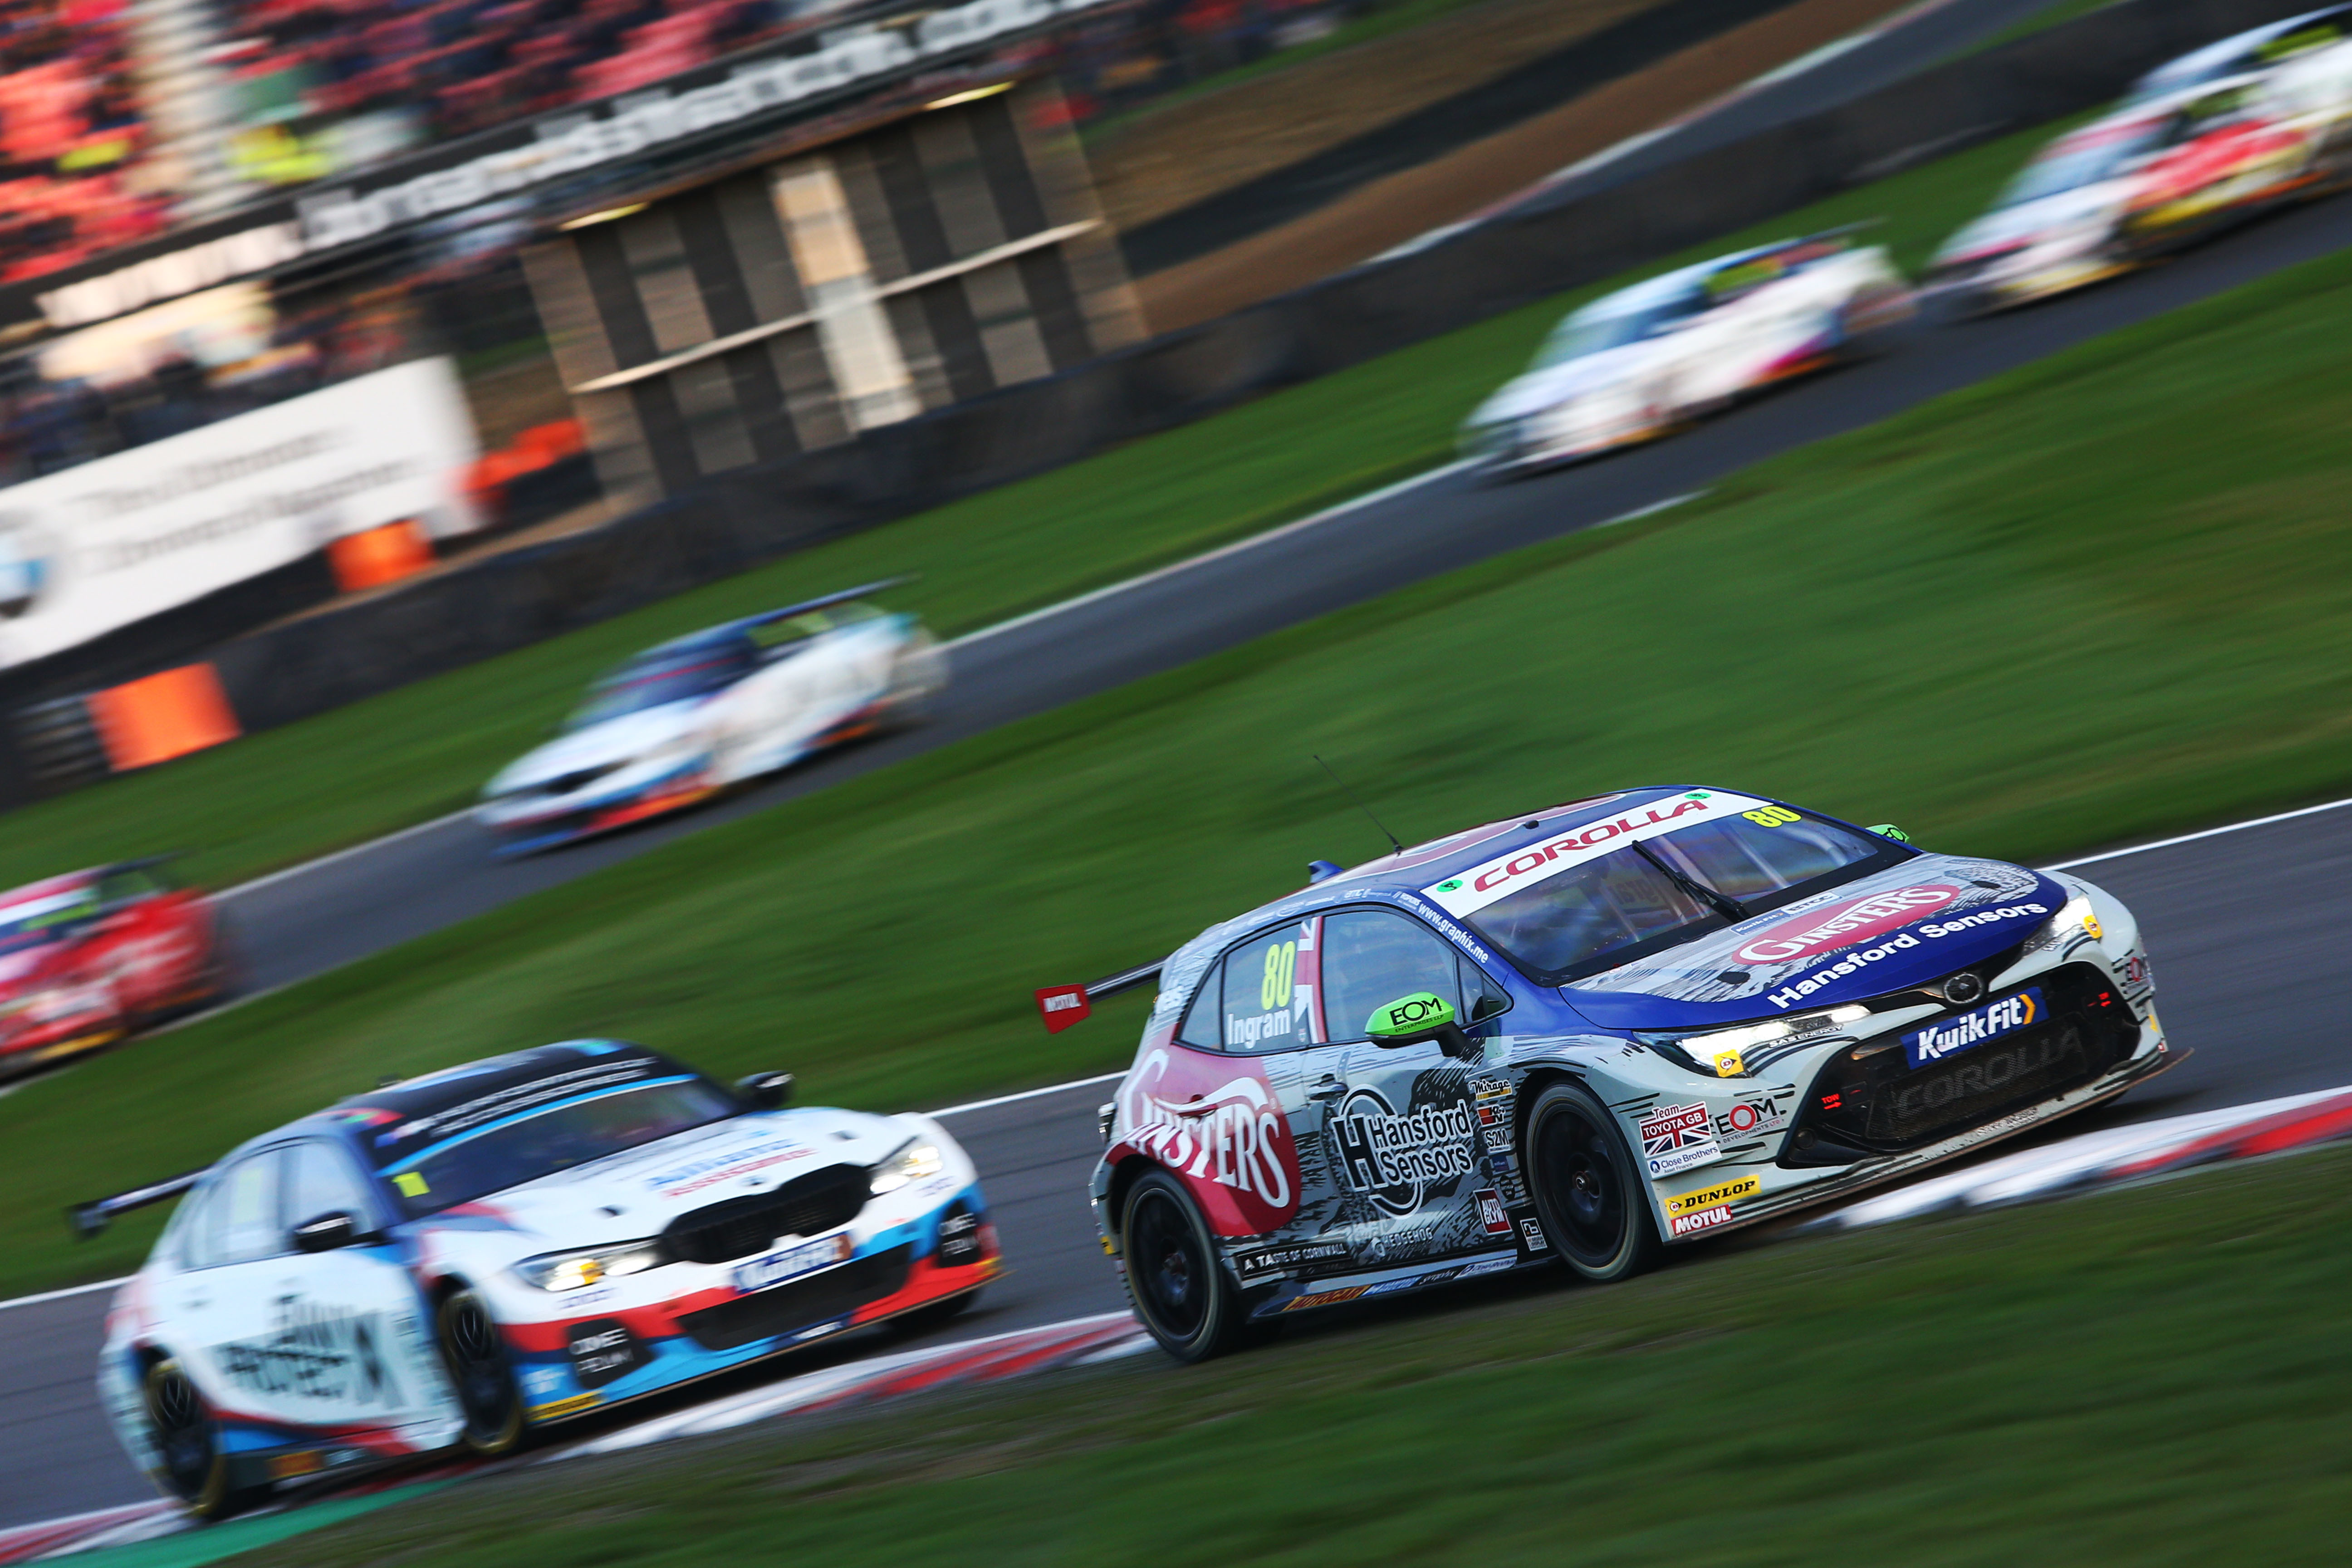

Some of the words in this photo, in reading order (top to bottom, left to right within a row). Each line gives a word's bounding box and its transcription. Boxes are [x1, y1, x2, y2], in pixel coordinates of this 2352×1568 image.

[1741, 805, 1802, 828] 80
[1474, 799, 1709, 892] COROLLA
[1418, 903, 1489, 964] www.graphix.me
[1740, 888, 1951, 961] GINSTERS
[1768, 933, 1920, 1009] Hansford
[1918, 902, 2048, 939] Sensors
[1261, 941, 1296, 1010] 80
[1390, 998, 1442, 1026] EOM
[1395, 1018, 1433, 1033] ENTERPRISES
[1228, 1009, 1291, 1049] Ingram
[1769, 1035, 1796, 1049] SAS
[1795, 1024, 1844, 1040] ENERGY
[1469, 1079, 1510, 1093] Mirage
[1821, 1093, 1840, 1104] TOW
[1367, 1102, 1472, 1149] Hansford
[1643, 1117, 1686, 1137] TOYOTA
[1686, 1112, 1703, 1124] GB
[1654, 1104, 1680, 1120] Team
[1715, 1098, 1778, 1135] EOM
[1118, 1049, 1290, 1208] GINSTERS
[1485, 1129, 1510, 1147] S2M
[1723, 1124, 1769, 1143] DEVELOPMENTS
[1377, 1145, 1472, 1182] Sensors
[1661, 1157, 1681, 1168] Close
[1682, 1147, 1718, 1162] Brothers
[1482, 1198, 1501, 1212] AUTO
[1685, 1181, 1755, 1208] DUNLOP
[1484, 1210, 1505, 1225] GLYM
[1676, 1205, 1731, 1234] MOTUL
[1244, 1259, 1255, 1271] A
[1256, 1250, 1288, 1267] TASTE
[1289, 1250, 1301, 1261] OF
[1302, 1243, 1347, 1259] CORNWALL
[1289, 1285, 1362, 1309] AUTOCAR
